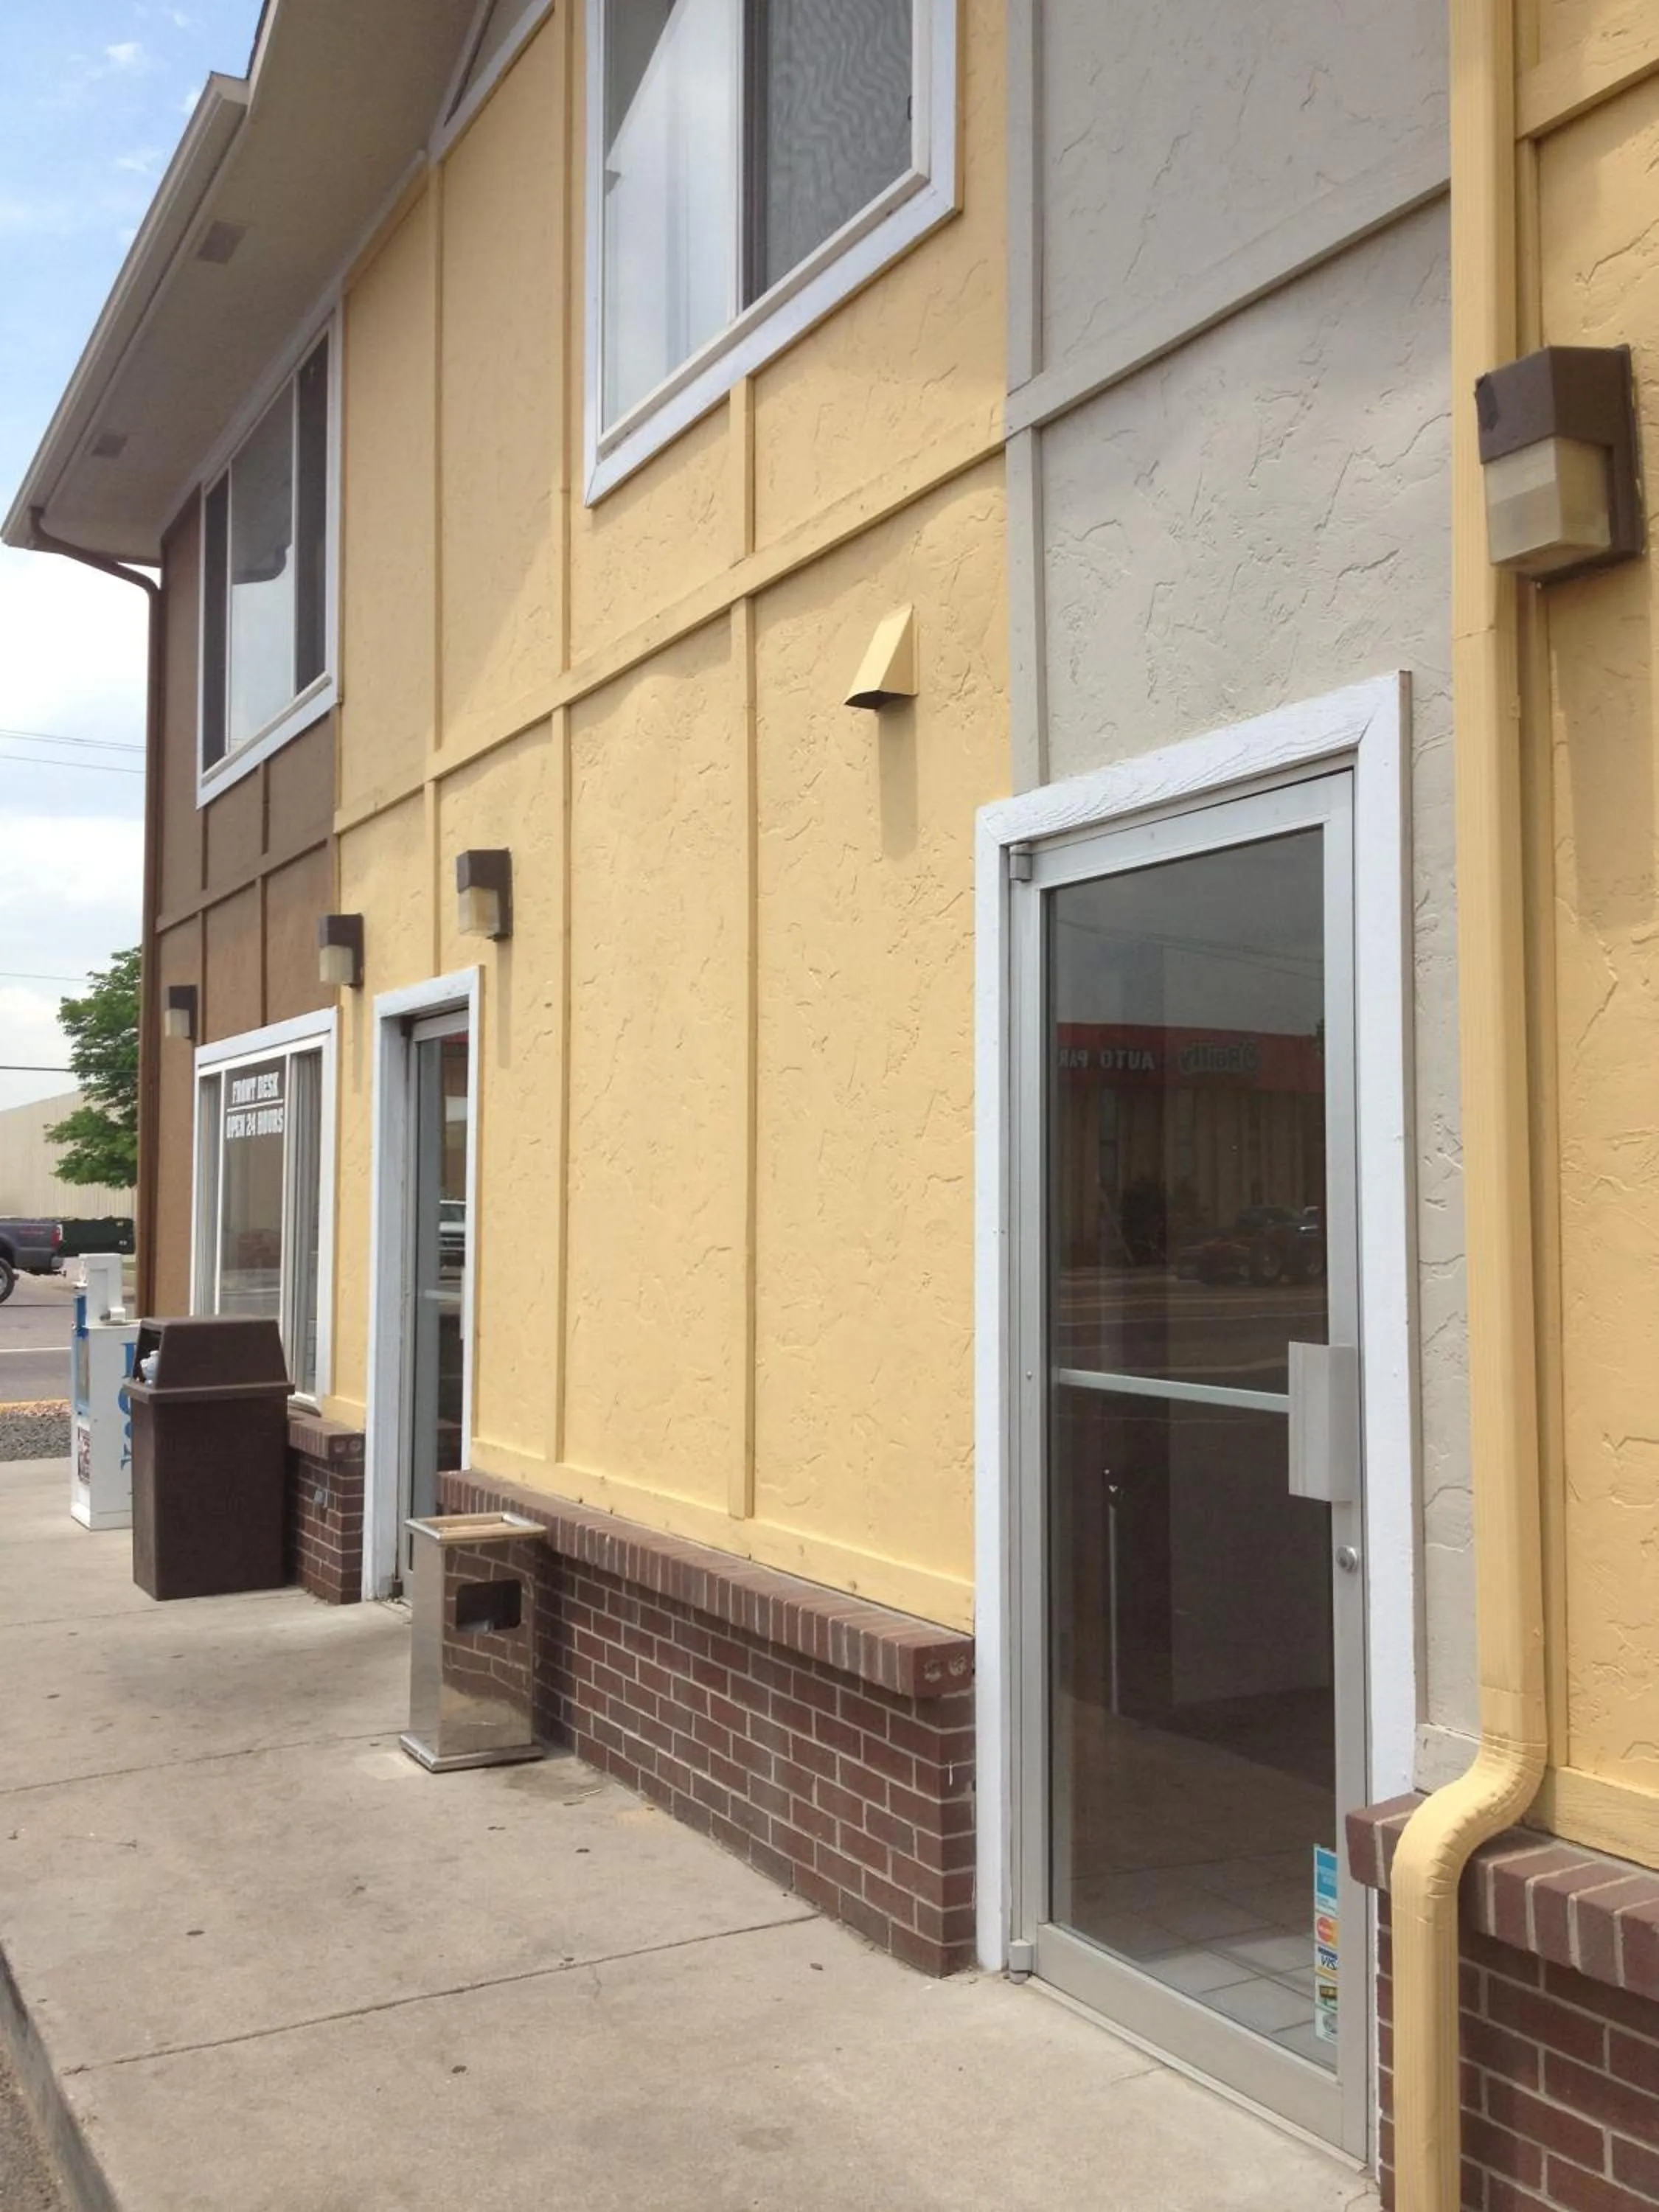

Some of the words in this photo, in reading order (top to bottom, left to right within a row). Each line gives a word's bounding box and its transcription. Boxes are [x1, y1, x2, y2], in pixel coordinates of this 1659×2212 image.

[232, 1077, 257, 1104] FRONT
[257, 1071, 279, 1099] DESK
[226, 1114, 246, 1139] OPEN
[246, 1112, 256, 1136] 24
[257, 1107, 283, 1135] HOURS
